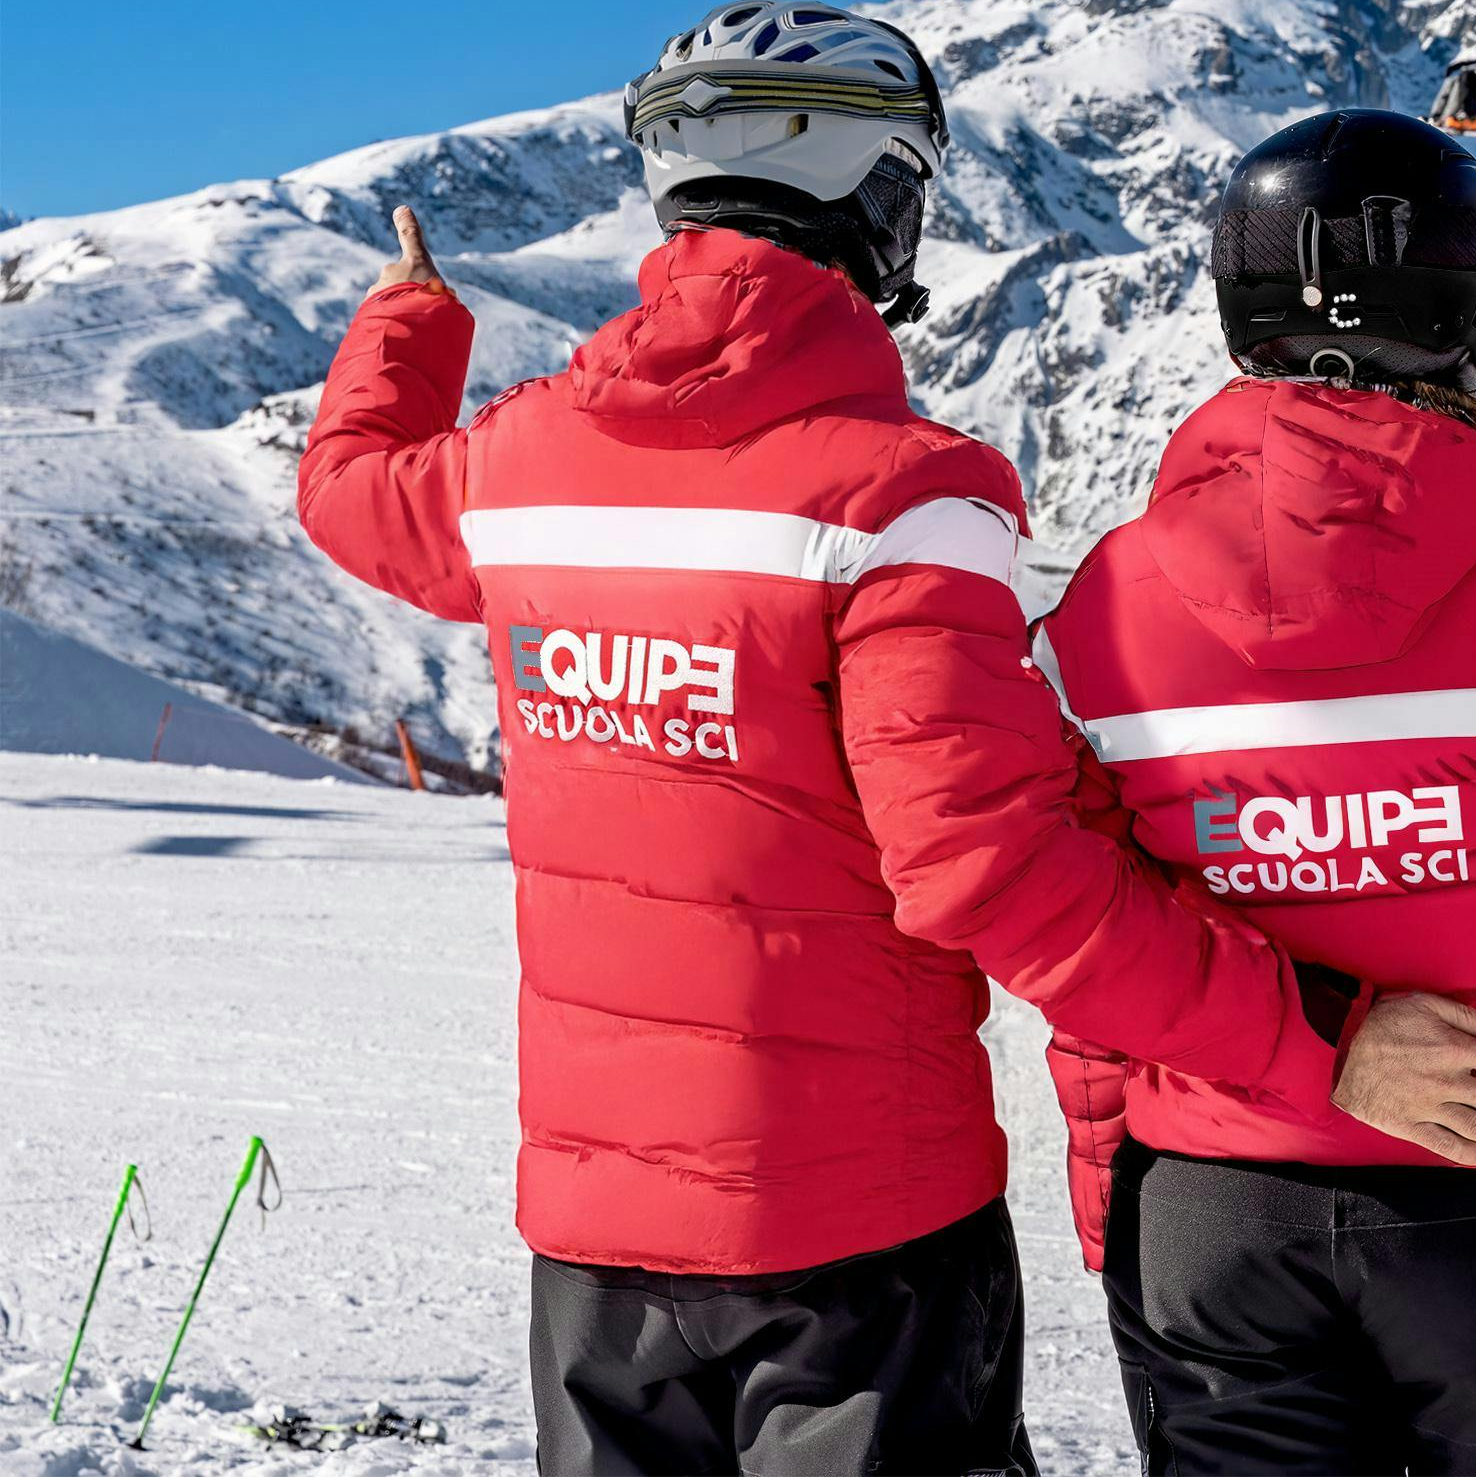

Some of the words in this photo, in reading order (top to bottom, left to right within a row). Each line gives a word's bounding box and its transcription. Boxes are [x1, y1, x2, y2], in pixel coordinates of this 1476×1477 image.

[509, 625, 736, 716] EQUIPE
[516, 698, 656, 752] SCUOLA
[664, 718, 739, 762] SCI
[1193, 785, 1464, 862] EQUIPE
[1202, 856, 1389, 895] SCUOLA
[1399, 848, 1470, 884] SCI
